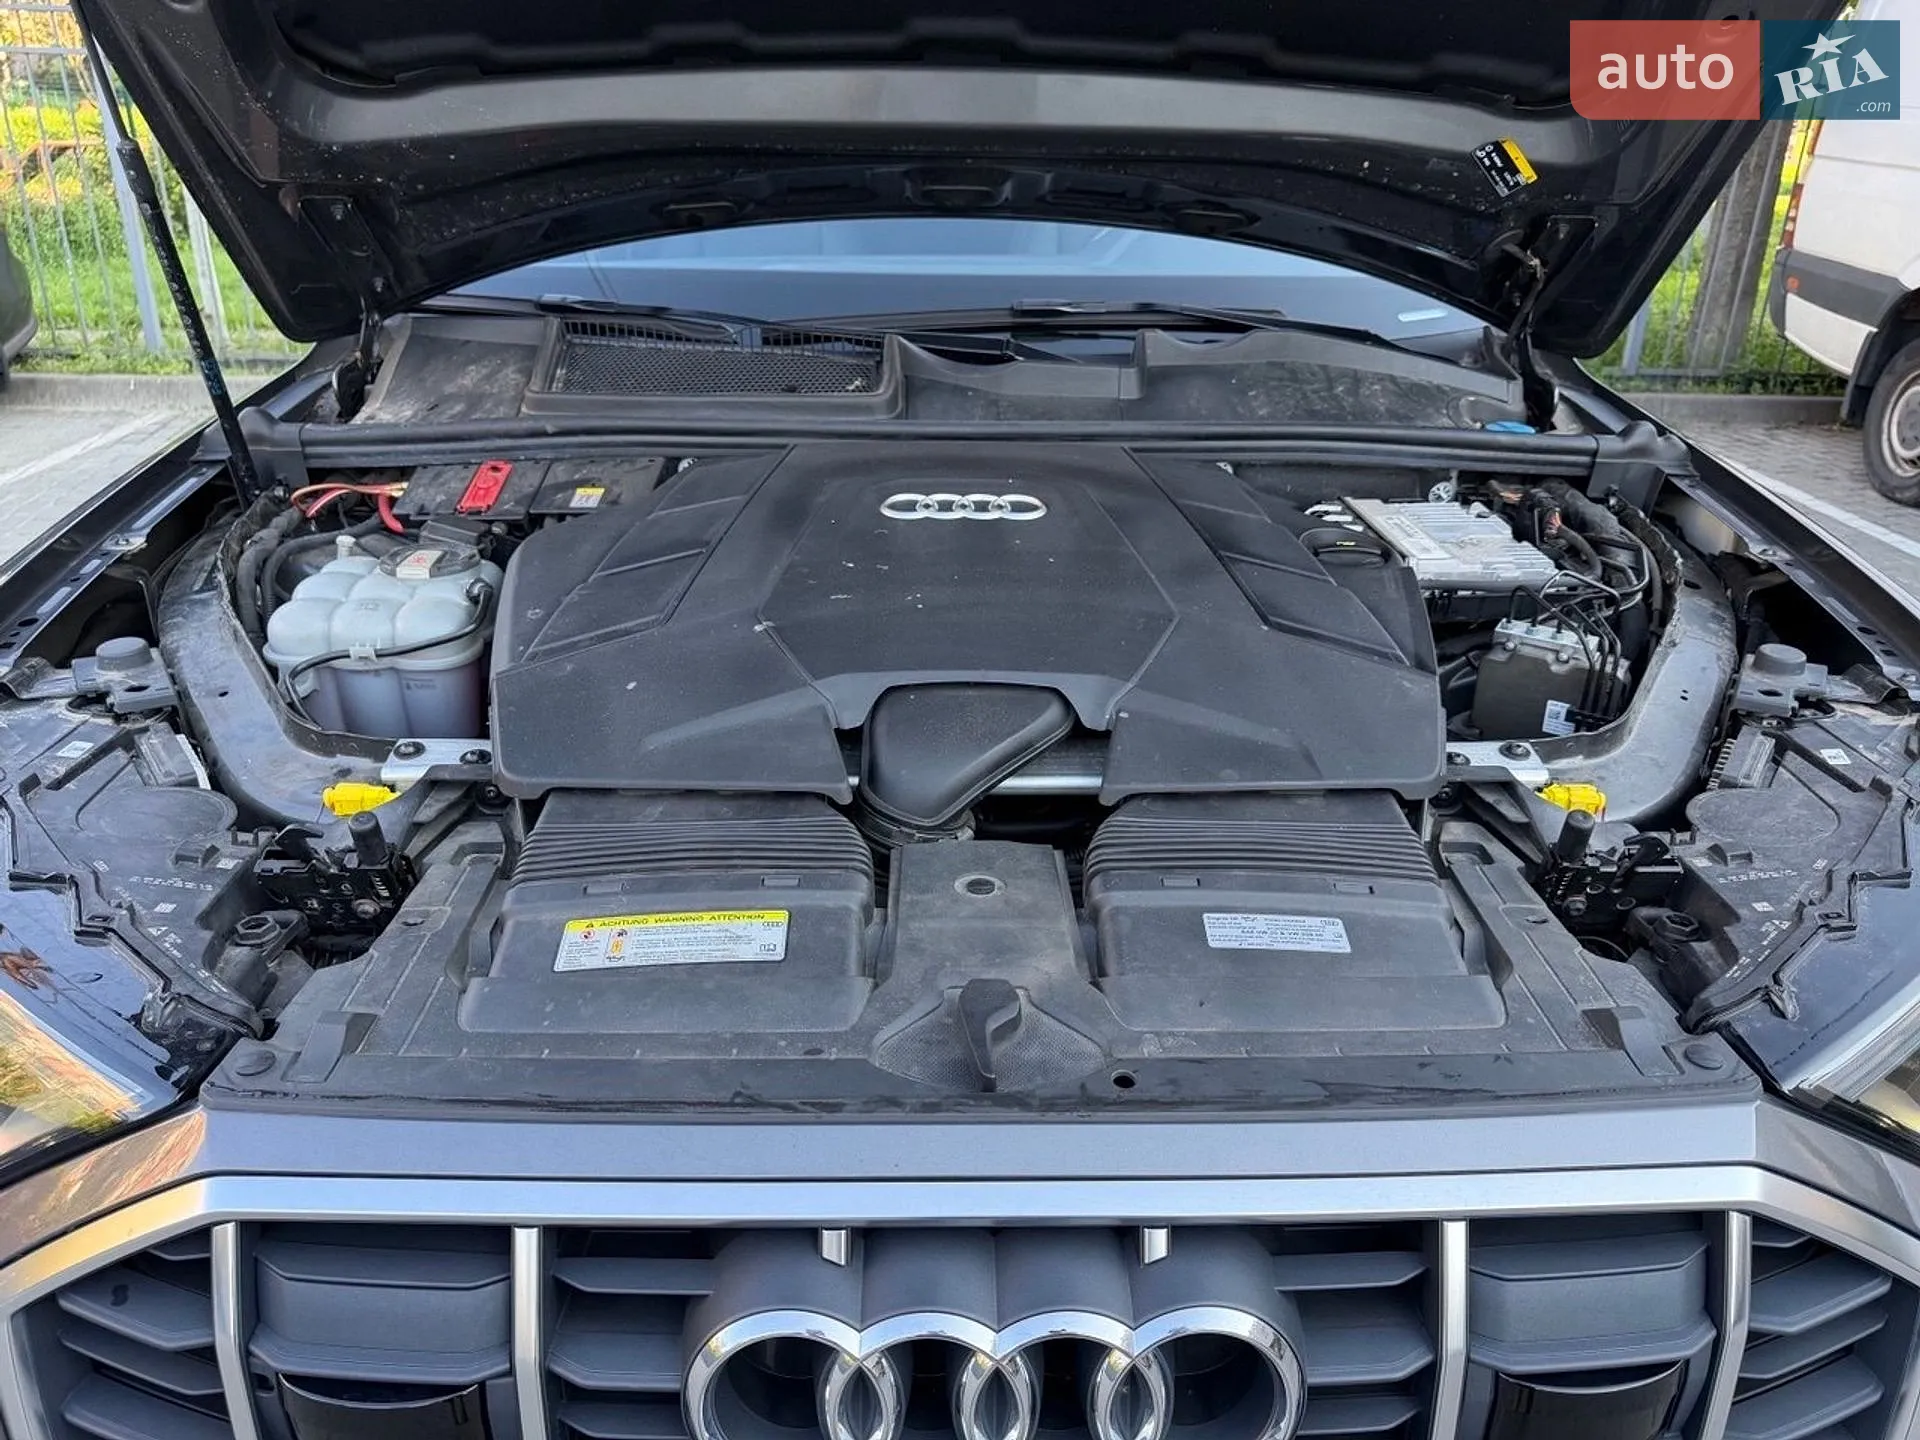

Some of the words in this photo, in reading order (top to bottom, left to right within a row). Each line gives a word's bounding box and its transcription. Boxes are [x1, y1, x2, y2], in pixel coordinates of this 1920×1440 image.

[599, 917, 649, 927] ACHTUNG
[653, 914, 705, 924] WARNING
[708, 912, 766, 922] ATTENTION
